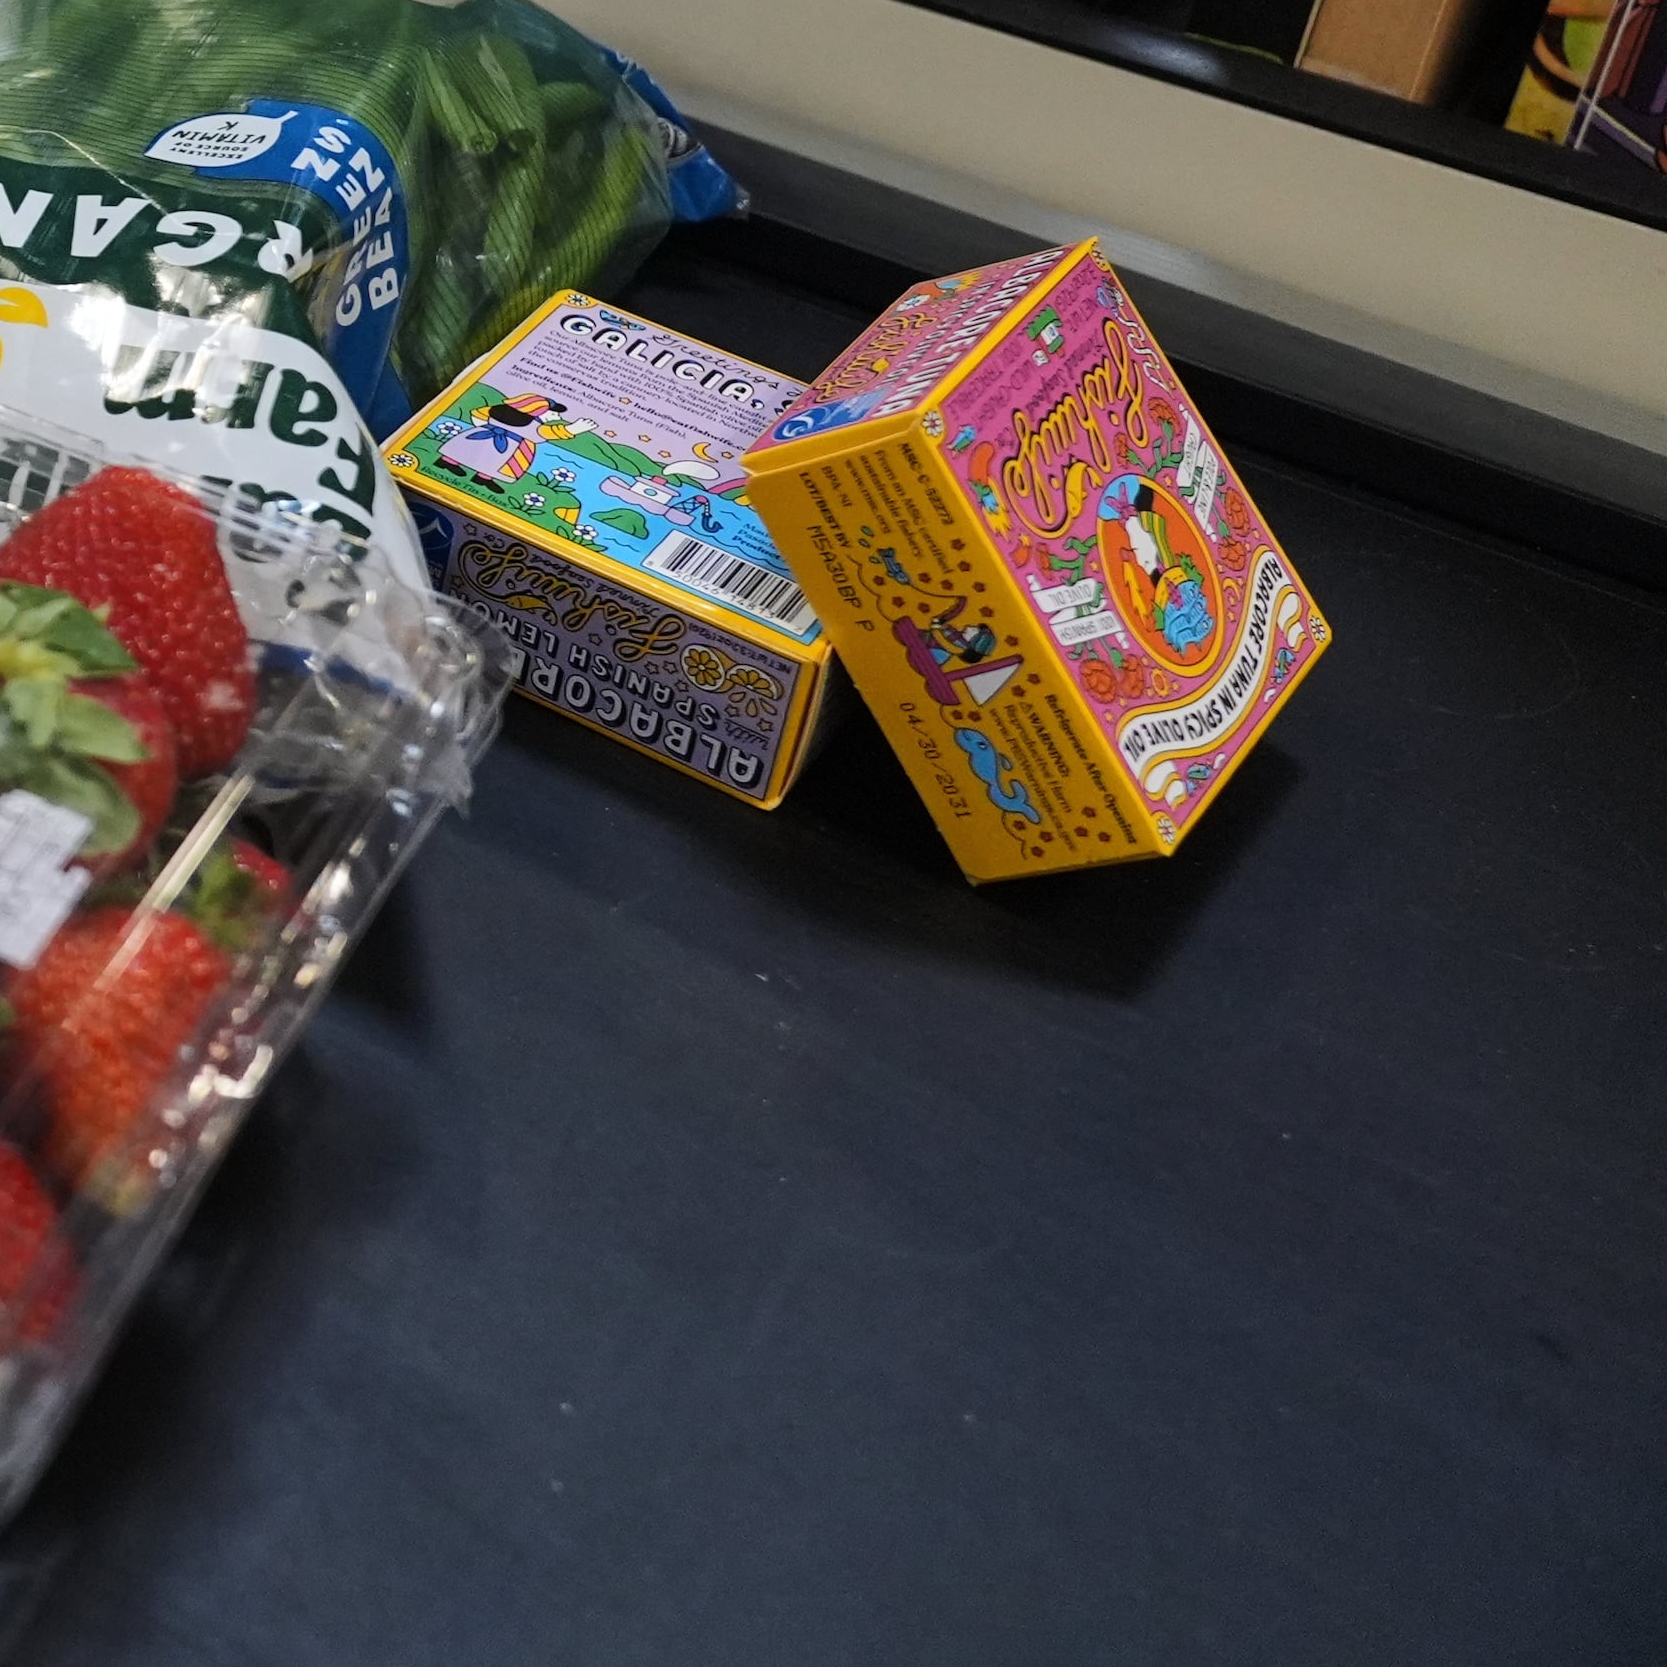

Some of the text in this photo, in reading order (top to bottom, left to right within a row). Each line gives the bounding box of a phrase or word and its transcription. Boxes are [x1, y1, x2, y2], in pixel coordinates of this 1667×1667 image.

[167, 145, 242, 161] EXCELLENT
[171, 125, 266, 146] VITAMIN
[193, 140, 247, 154] SOURCE
[222, 119, 238, 131] K
[274, 151, 377, 327] GREEN
[296, 124, 415, 311] BEANS
[558, 306, 771, 414] GALICIA,
[652, 329, 782, 394] Greetings
[873, 250, 1065, 417] ALBACORE TUNA
[509, 363, 578, 395] Ingredients:
[577, 390, 627, 414] Albacore
[1004, 318, 1148, 530] Fishwife
[798, 470, 850, 549] LOT/BEST BY
[857, 452, 925, 558] sustainable fishery
[873, 448, 897, 480] From
[900, 496, 924, 526] MSC
[917, 524, 953, 576] certified
[445, 522, 690, 680] Fishwife
[856, 620, 875, 632] P
[498, 634, 761, 793] ALBACORE
[566, 637, 719, 729] SPANISH
[1124, 558, 1282, 763] ALBACORE TUNA IN SPICY OLIVE OIL
[720, 718, 769, 752] with
[897, 699, 972, 822] 04/30/2031
[1002, 702, 1073, 815] Reproductive Harm
[1026, 710, 1071, 780] WARNING:
[1044, 691, 1139, 847] Refrigerate After Opening
